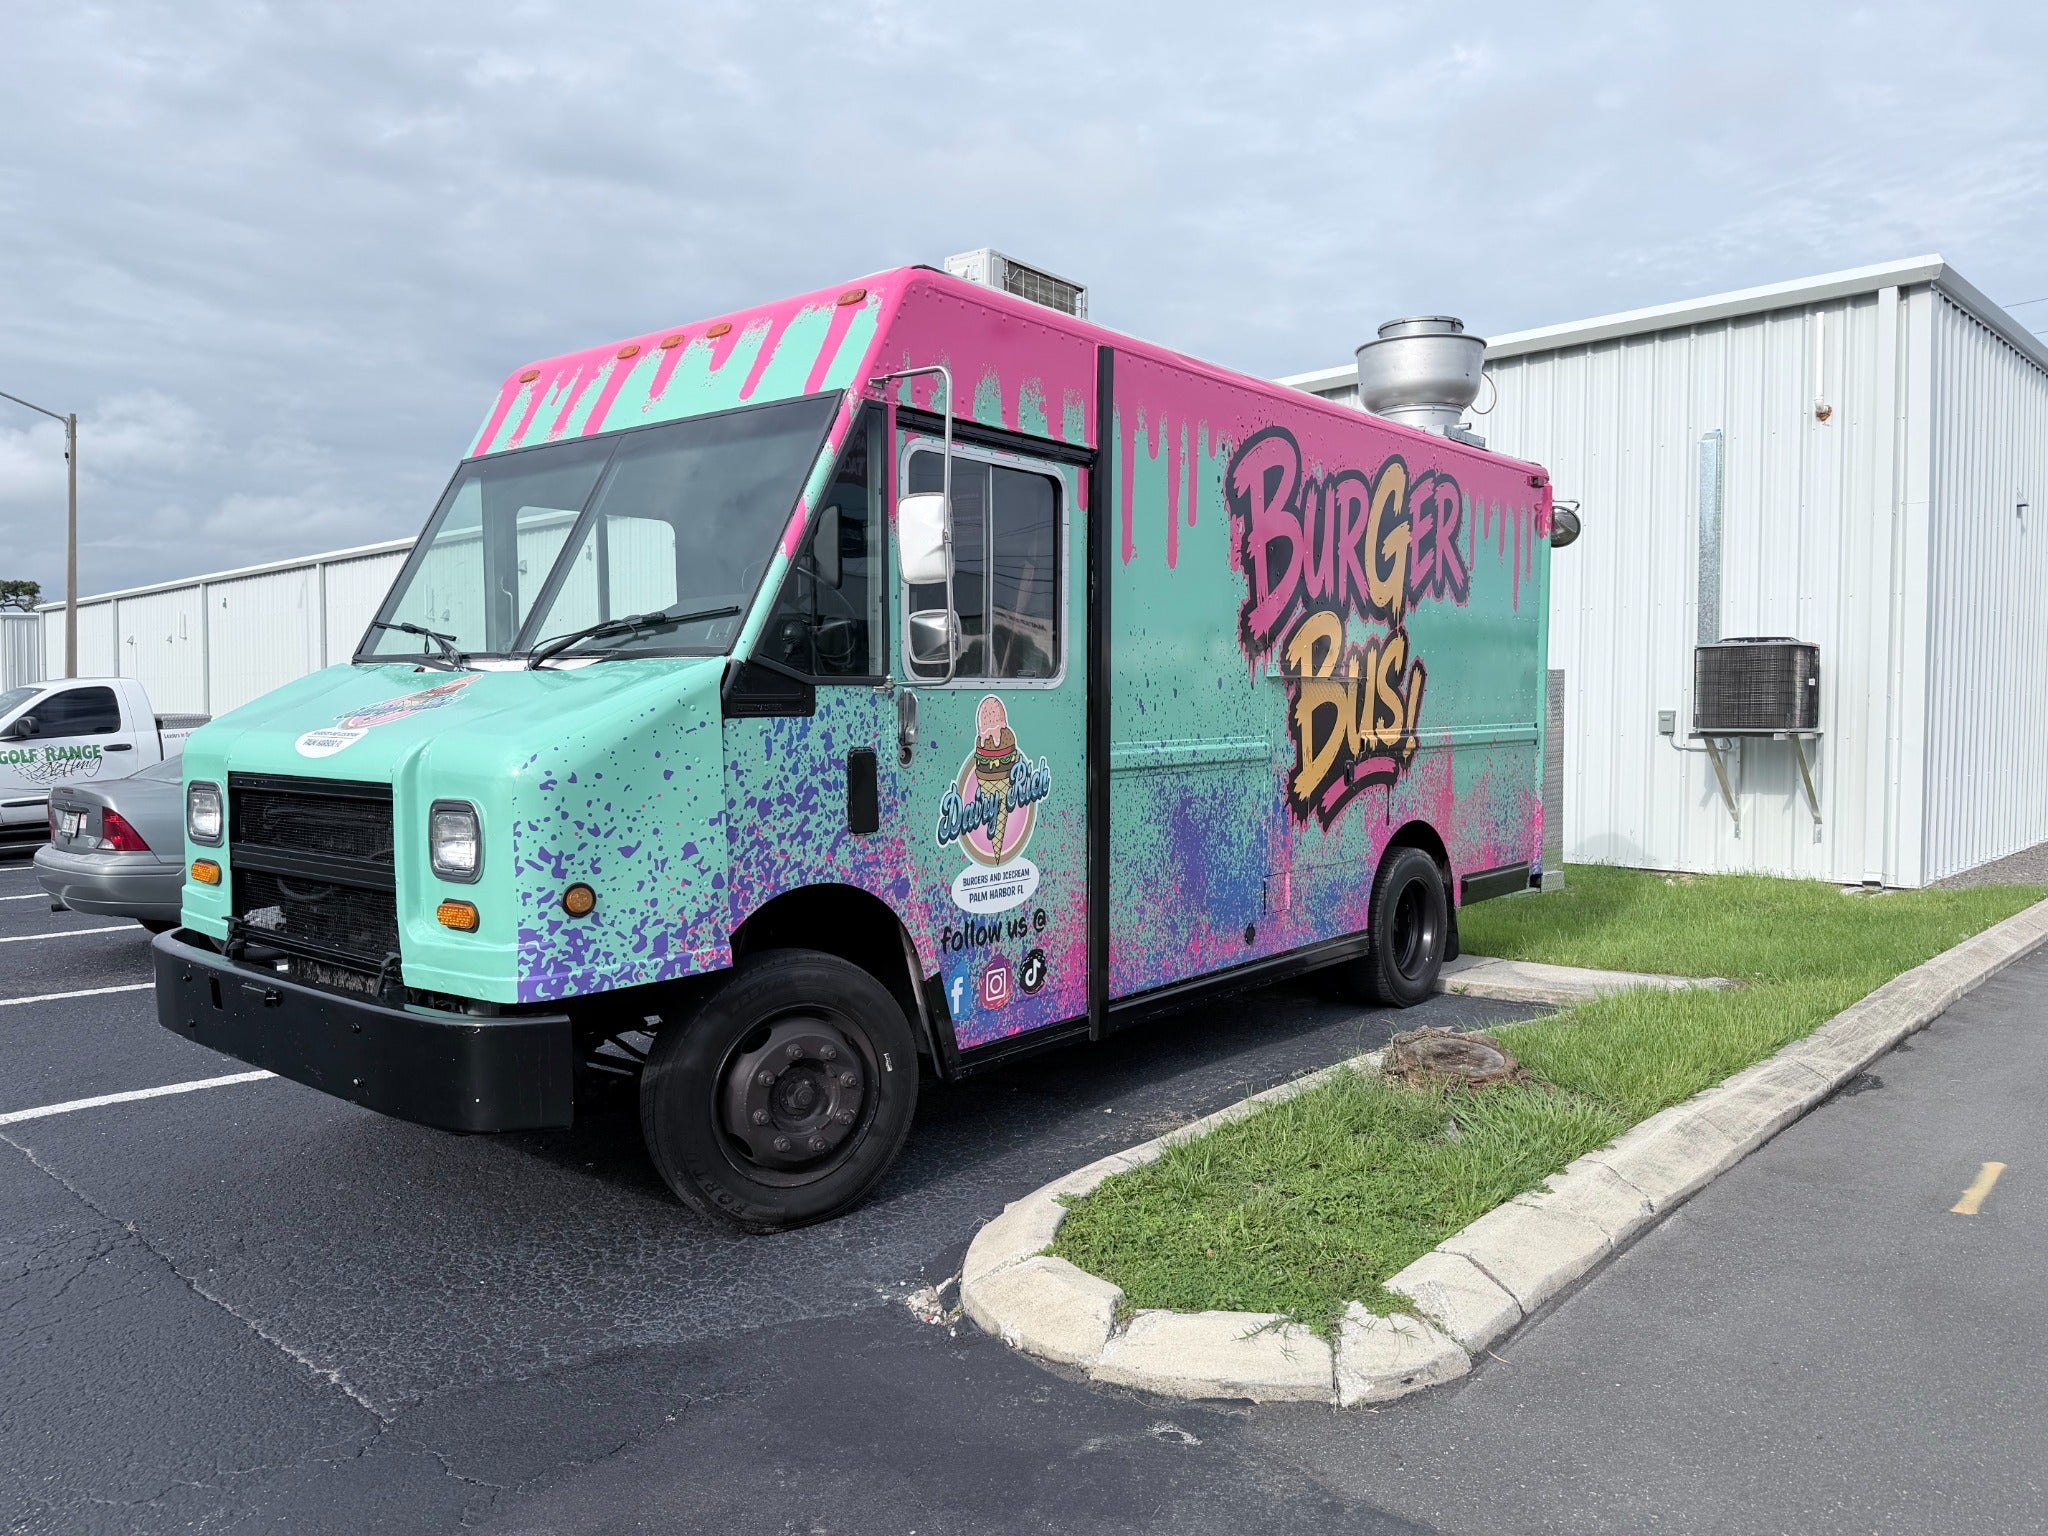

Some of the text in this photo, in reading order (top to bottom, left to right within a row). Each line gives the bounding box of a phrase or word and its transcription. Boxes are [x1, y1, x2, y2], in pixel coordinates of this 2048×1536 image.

[1229, 428, 1467, 648] BURGER
[1284, 610, 1424, 802] BUS!
[0, 744, 101, 765] GOLF RANGE
[937, 755, 1051, 846] Dairy Rich
[962, 867, 1030, 887] BURGERS AND ICECREAM
[969, 884, 1024, 903] PALM HARBOR FL
[1007, 916, 1028, 940] us
